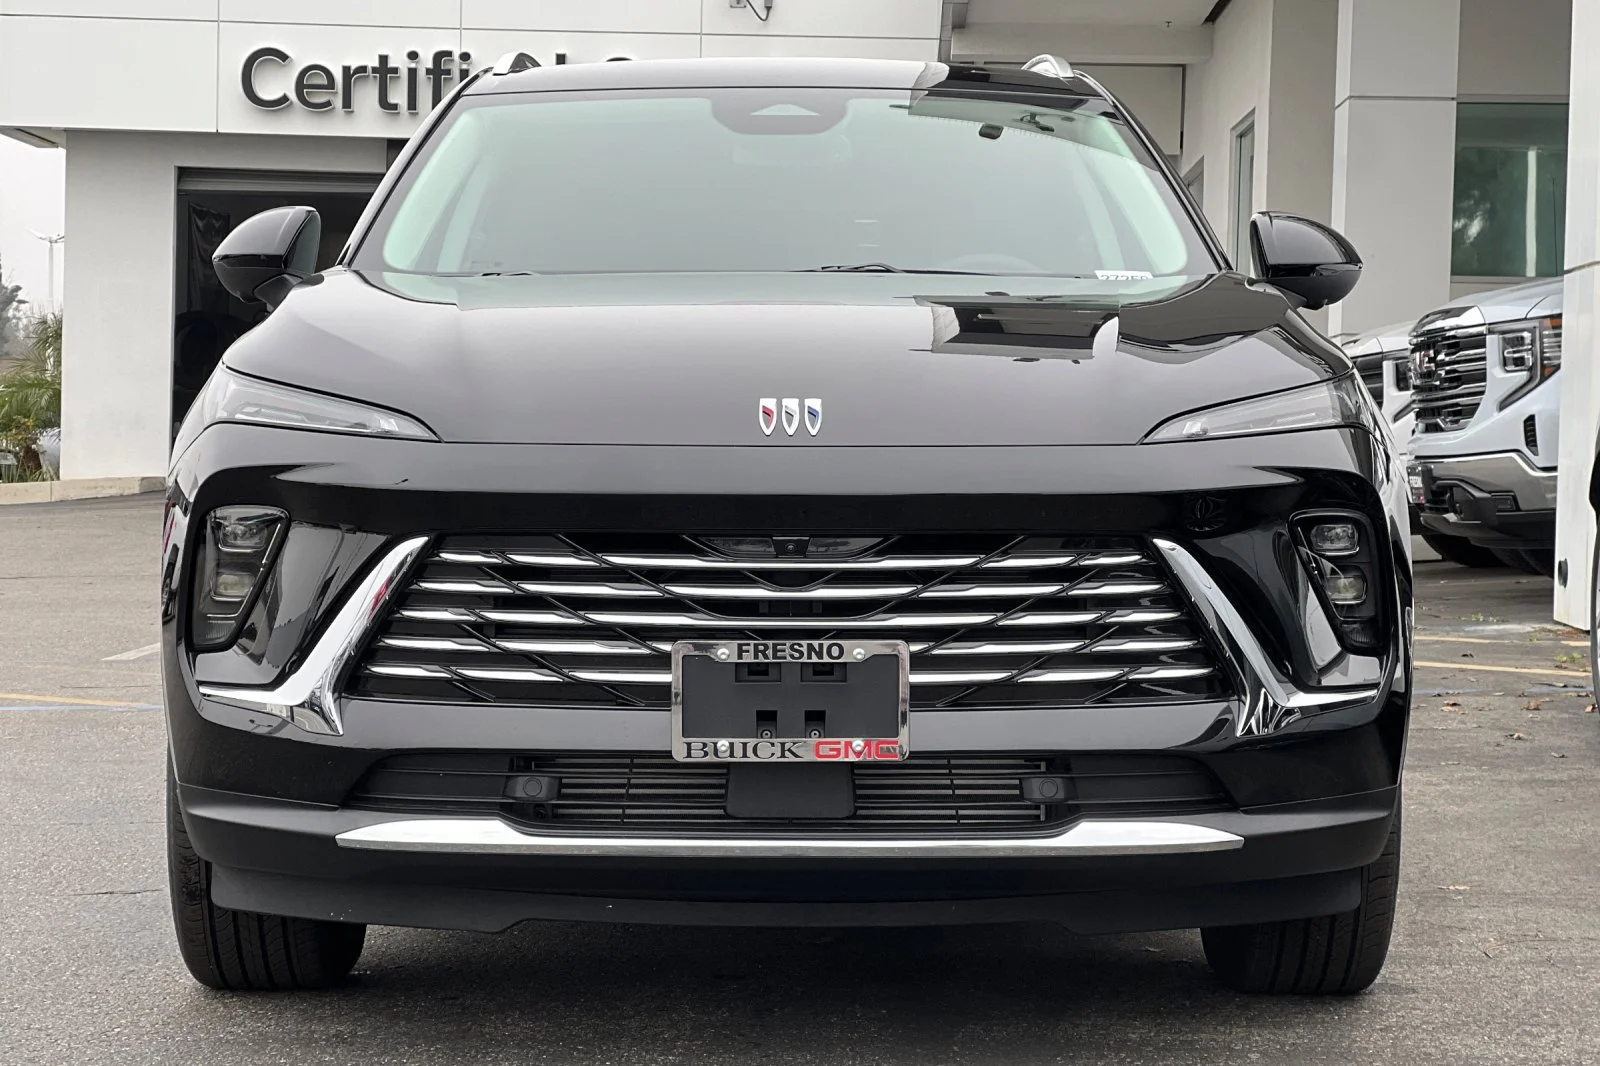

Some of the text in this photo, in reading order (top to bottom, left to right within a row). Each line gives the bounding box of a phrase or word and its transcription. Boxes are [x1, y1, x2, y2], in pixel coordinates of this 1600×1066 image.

[241, 46, 566, 113] Certifi
[737, 642, 845, 661] FRESNO
[682, 740, 899, 760] BUICK GMC
